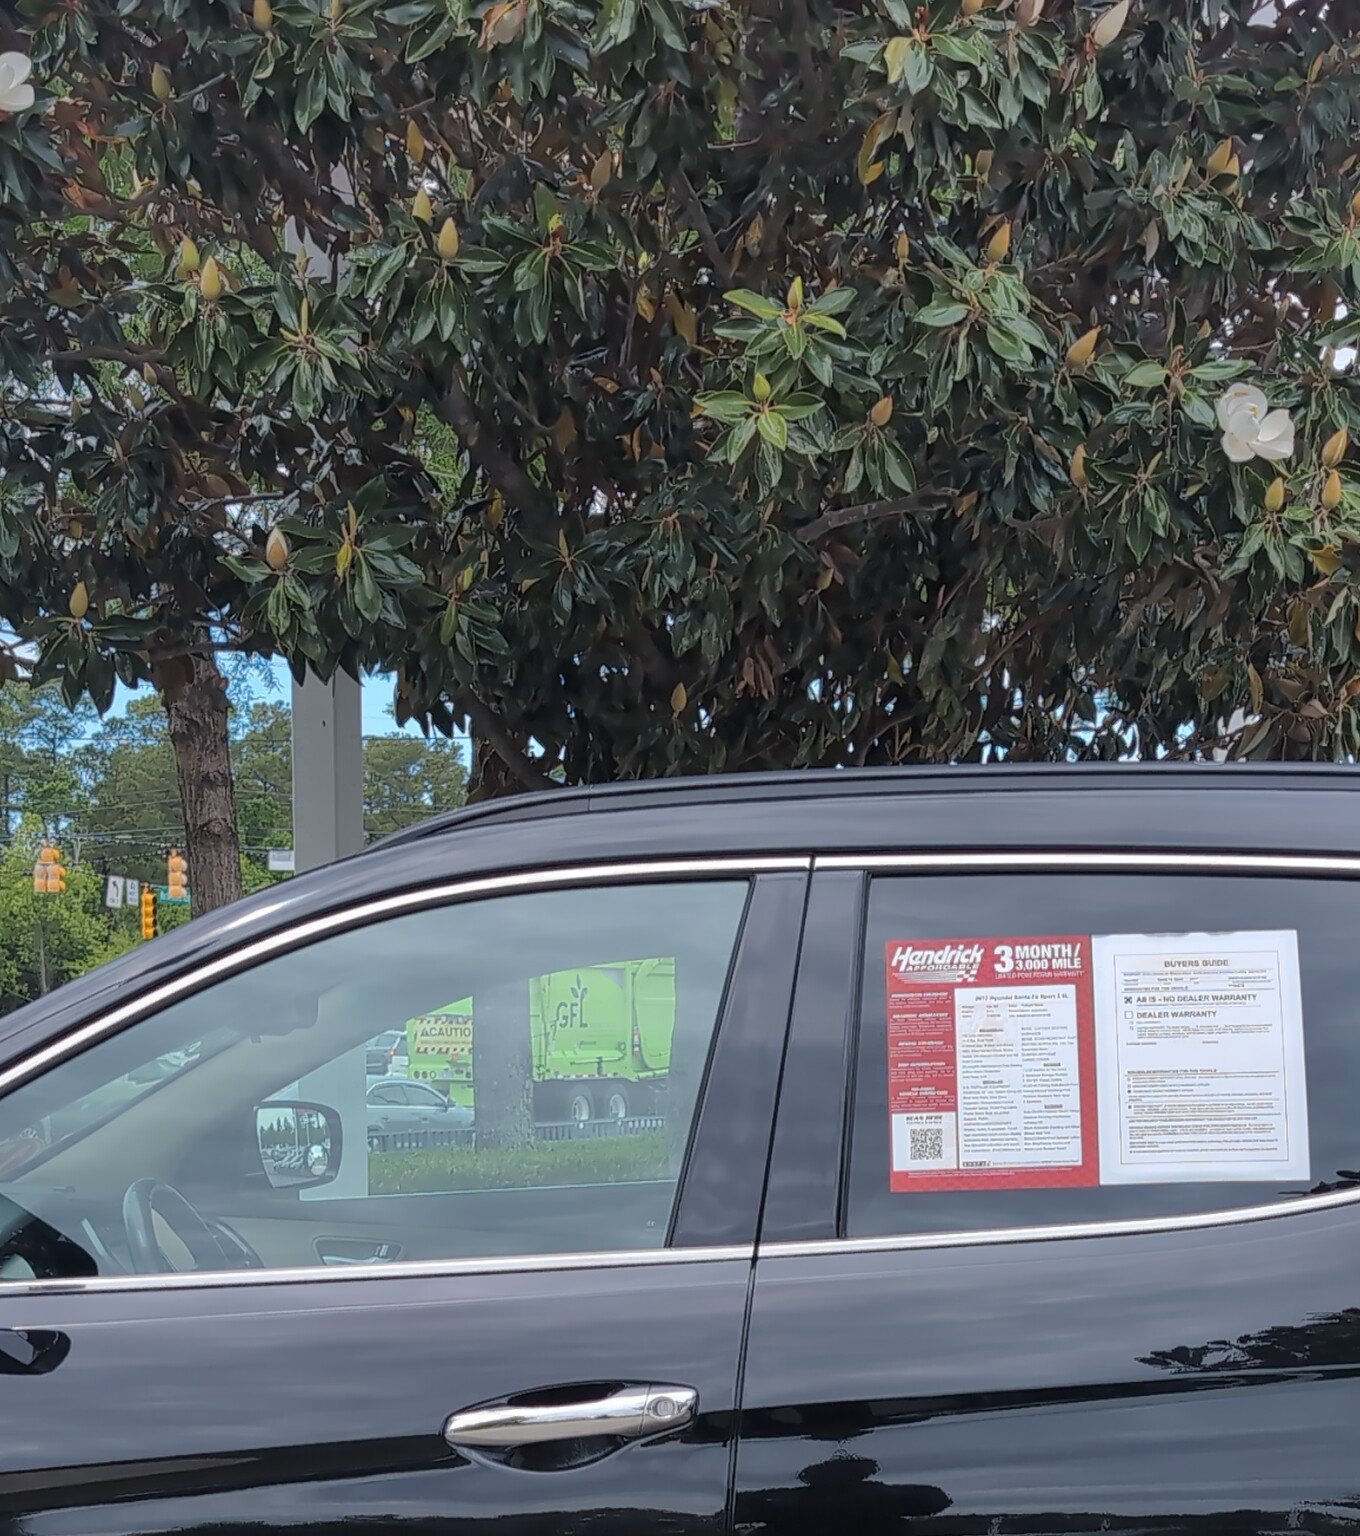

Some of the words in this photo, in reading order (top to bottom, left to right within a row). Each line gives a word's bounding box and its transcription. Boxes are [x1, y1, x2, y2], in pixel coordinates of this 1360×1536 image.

[891, 943, 985, 972] Hendrick
[994, 945, 1014, 973] 3
[1015, 960, 1048, 971] 3,000
[1051, 958, 1082, 970] MILE
[1164, 960, 1200, 968] BUYERS
[1202, 959, 1229, 967] GUIDE
[1163, 995, 1176, 1003] NO
[1210, 994, 1258, 1002] WARRANTY
[556, 1000, 589, 1029] GFL
[1136, 1010, 1169, 1019] DEALER
[1171, 1010, 1217, 1018] WARRANTY
[429, 1027, 472, 1037] CAUTIO
